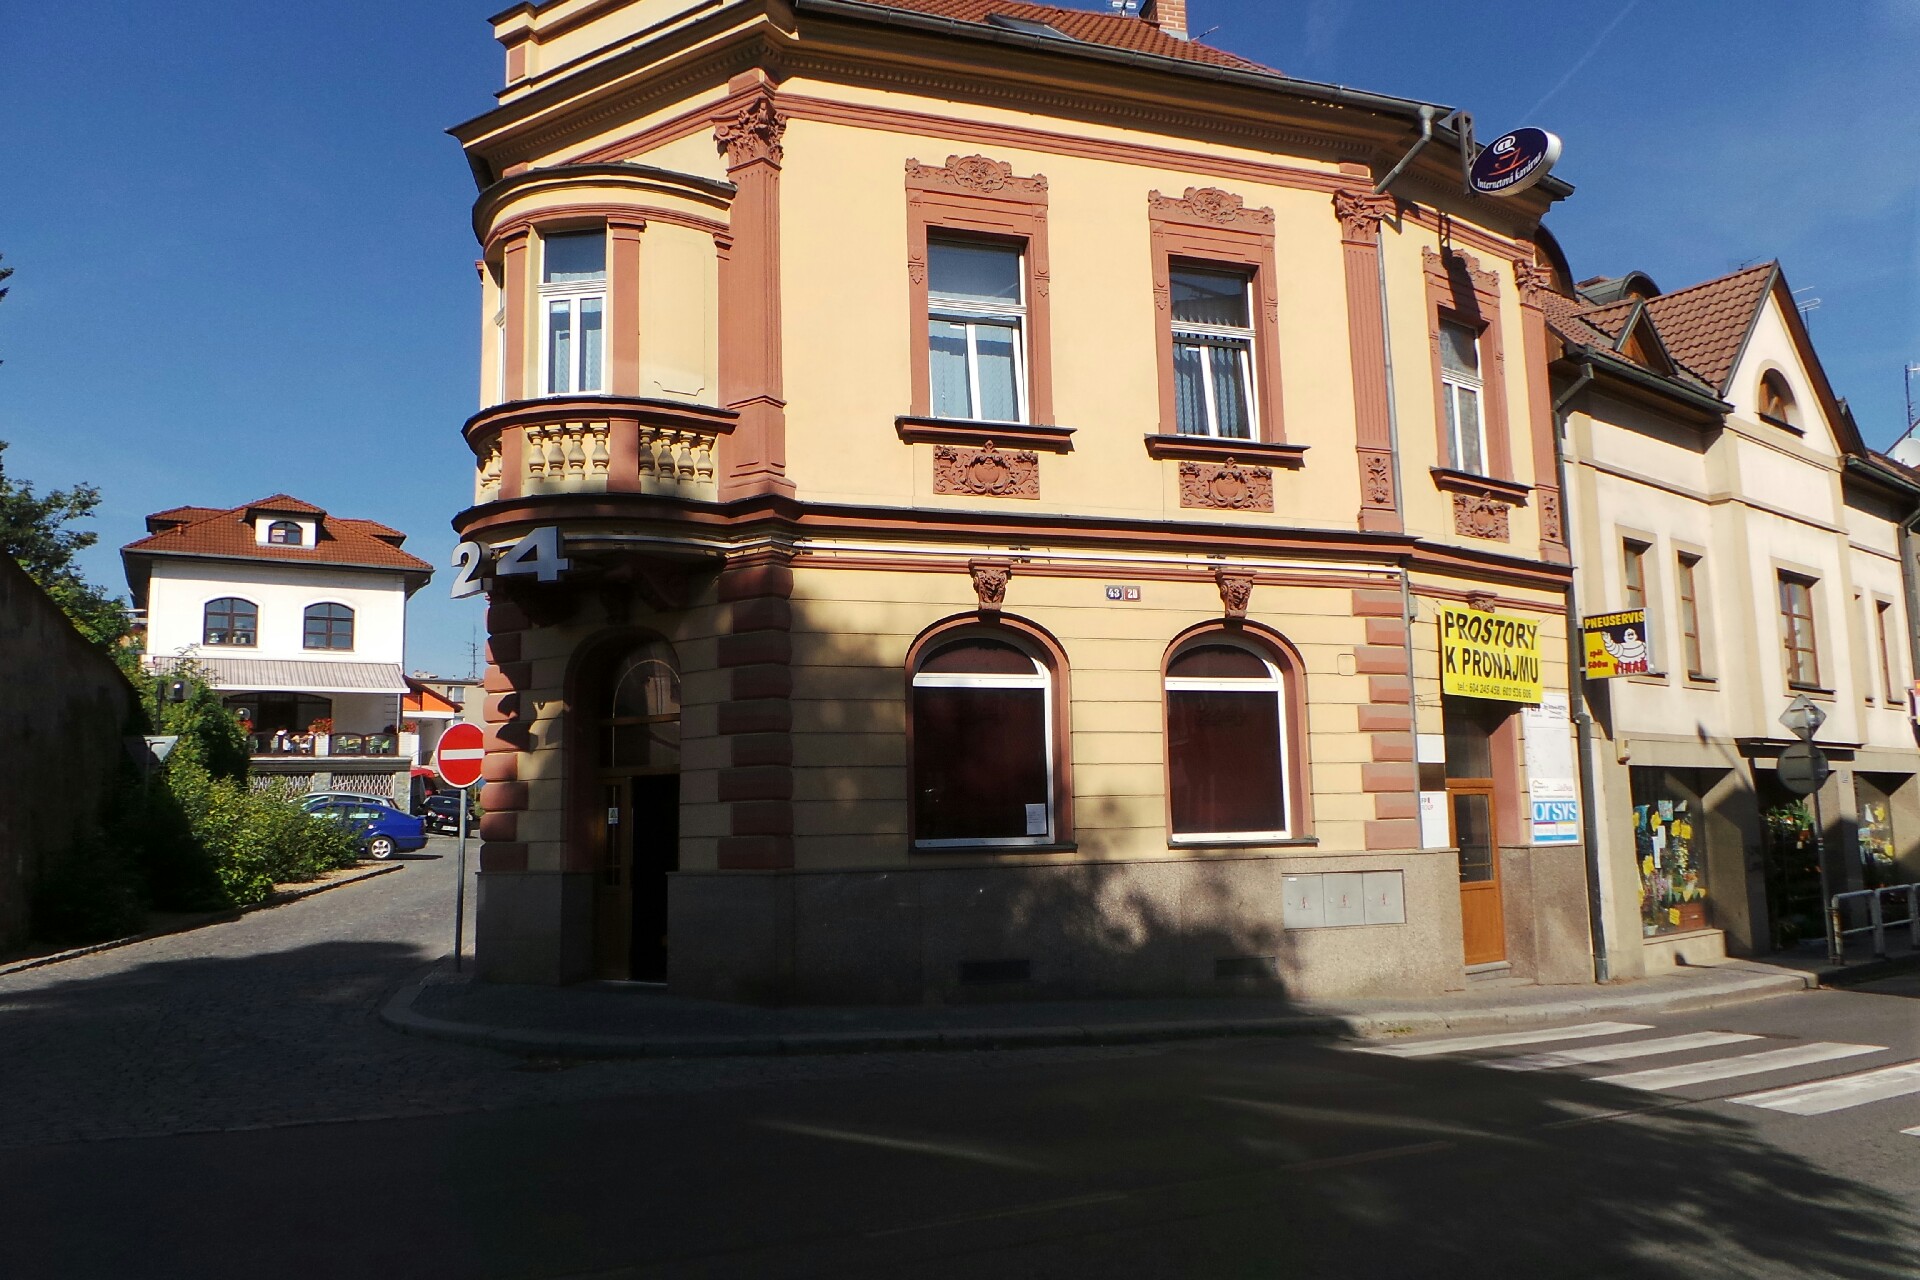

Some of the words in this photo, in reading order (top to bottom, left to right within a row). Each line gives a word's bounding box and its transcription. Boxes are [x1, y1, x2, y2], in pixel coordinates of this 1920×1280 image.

[1445, 611, 1537, 650] PROSTORY
[1584, 611, 1645, 629] PNEUSERVIS
[1445, 645, 1457, 674] K
[1462, 648, 1538, 684] PRONÁJMU
